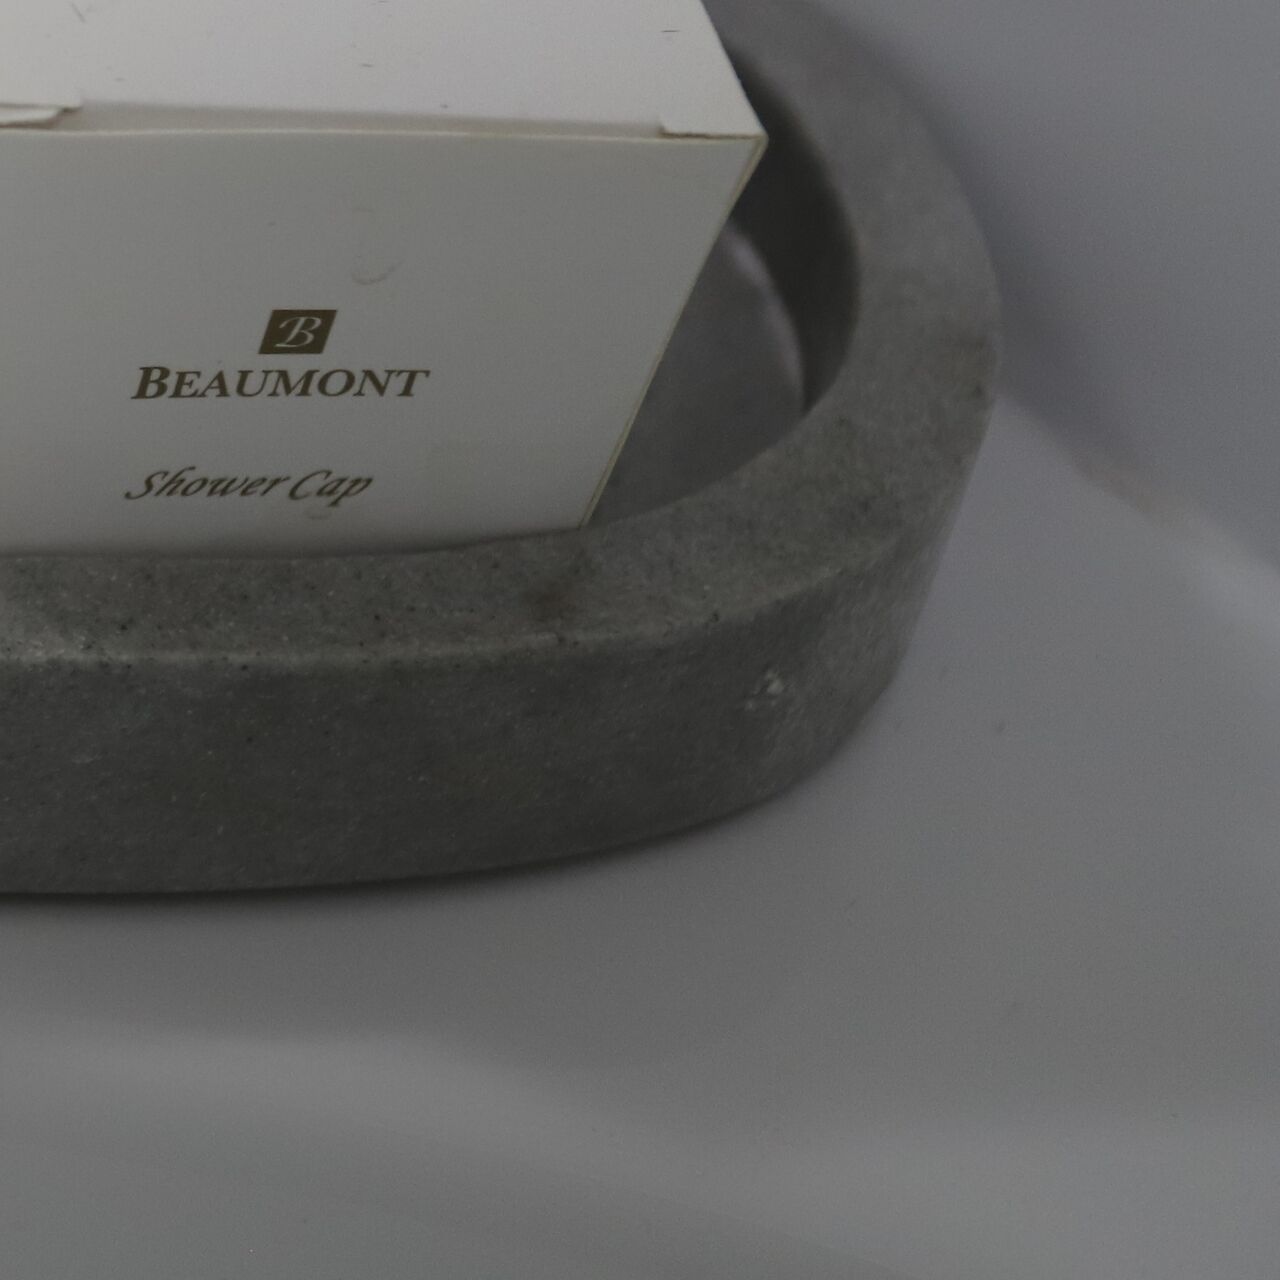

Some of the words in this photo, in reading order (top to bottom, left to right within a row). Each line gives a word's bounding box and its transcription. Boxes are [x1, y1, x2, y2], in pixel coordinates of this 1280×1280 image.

[270, 314, 324, 351] B
[130, 365, 431, 400] BEAUMONT
[124, 465, 290, 500] Shower
[288, 469, 373, 507] Cap
